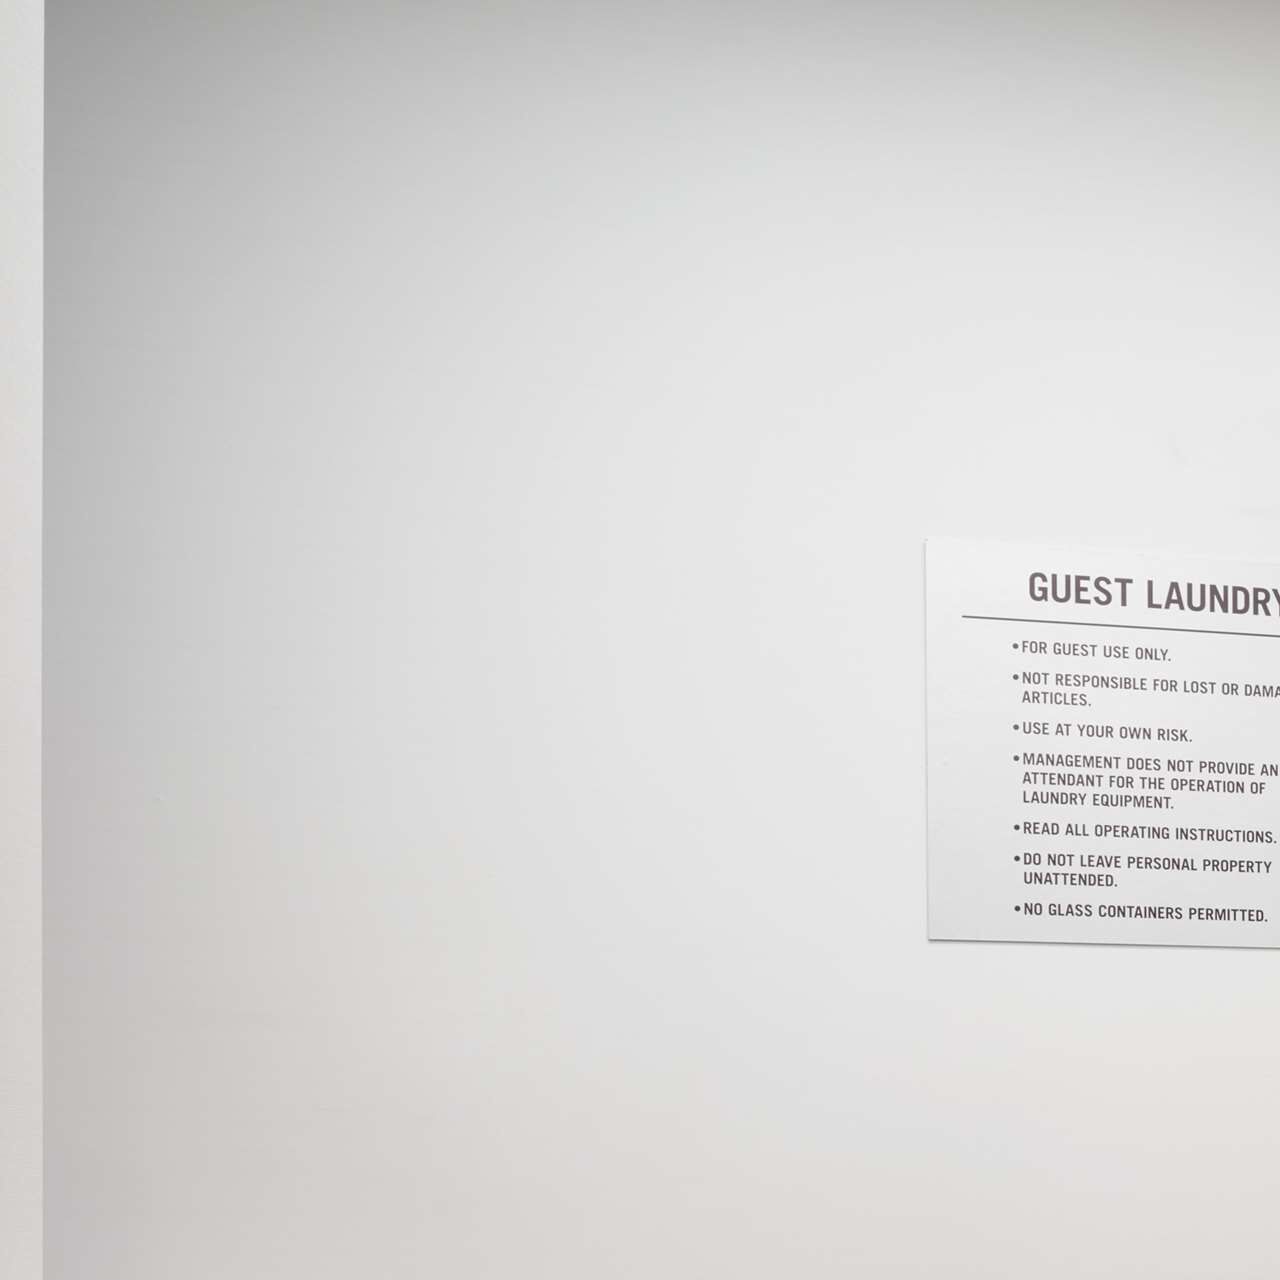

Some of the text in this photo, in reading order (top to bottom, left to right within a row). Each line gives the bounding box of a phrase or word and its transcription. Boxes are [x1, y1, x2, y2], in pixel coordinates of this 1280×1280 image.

[1028, 571, 1134, 608] GUEST
[1021, 640, 1172, 662] FOR GUEST USE ONLY.
[1021, 671, 1051, 686] NOT
[1055, 672, 1148, 691] RESPONSIBLE
[1152, 678, 1179, 693] FOR
[1183, 679, 1217, 695] LOST
[1220, 682, 1240, 697] OR
[1021, 689, 1092, 708] ARTICLES.
[1022, 721, 1193, 743] USE AT YOUR OWN RISK.
[1022, 751, 1279, 777] MANAGEMENT DOES NOT PROVIDE AN
[1022, 771, 1267, 795] ATTENDANT FOR THE OPERATION OF
[1022, 790, 1175, 810] LAUNDRY EQUIPMENT.
[1023, 821, 1278, 845] READ ALL OPERATING INSTRUCTIONS.
[1023, 851, 1273, 874] DO NOT LEAVE PERSONAL PROPERTY
[1023, 871, 1119, 888] UNATTENDED.
[1023, 902, 1269, 923] NO GLASS CONTAINERS PERMITTED.
